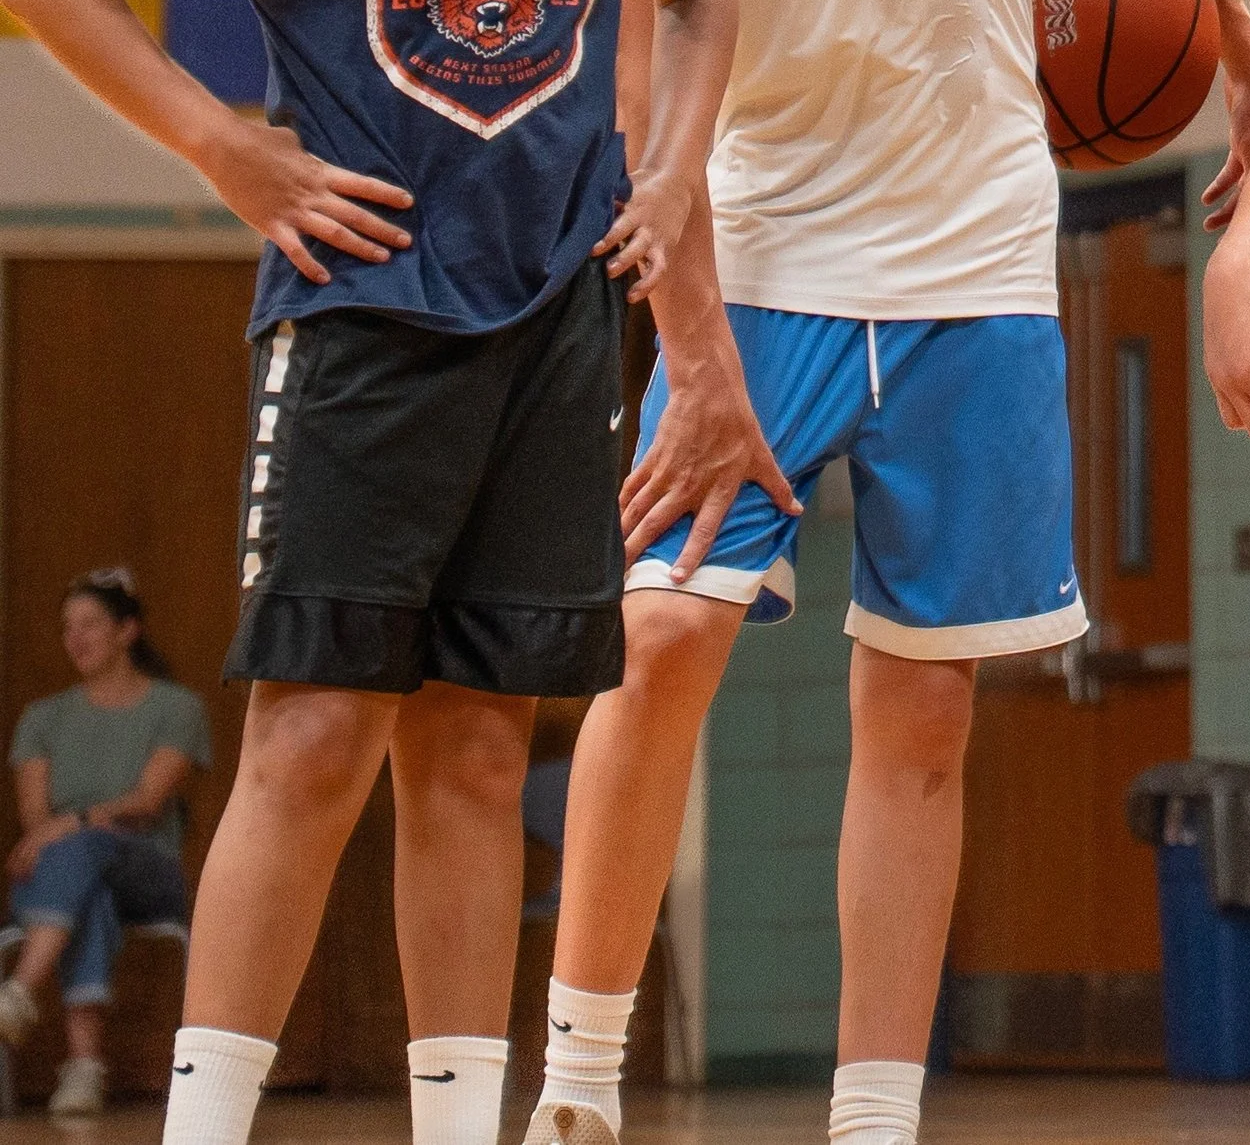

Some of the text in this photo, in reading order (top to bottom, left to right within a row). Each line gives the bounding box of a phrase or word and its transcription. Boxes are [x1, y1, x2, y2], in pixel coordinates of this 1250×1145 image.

[408, 49, 562, 85] BEGINS THIS SUMMER
[442, 56, 532, 73] NEXT SEASON
